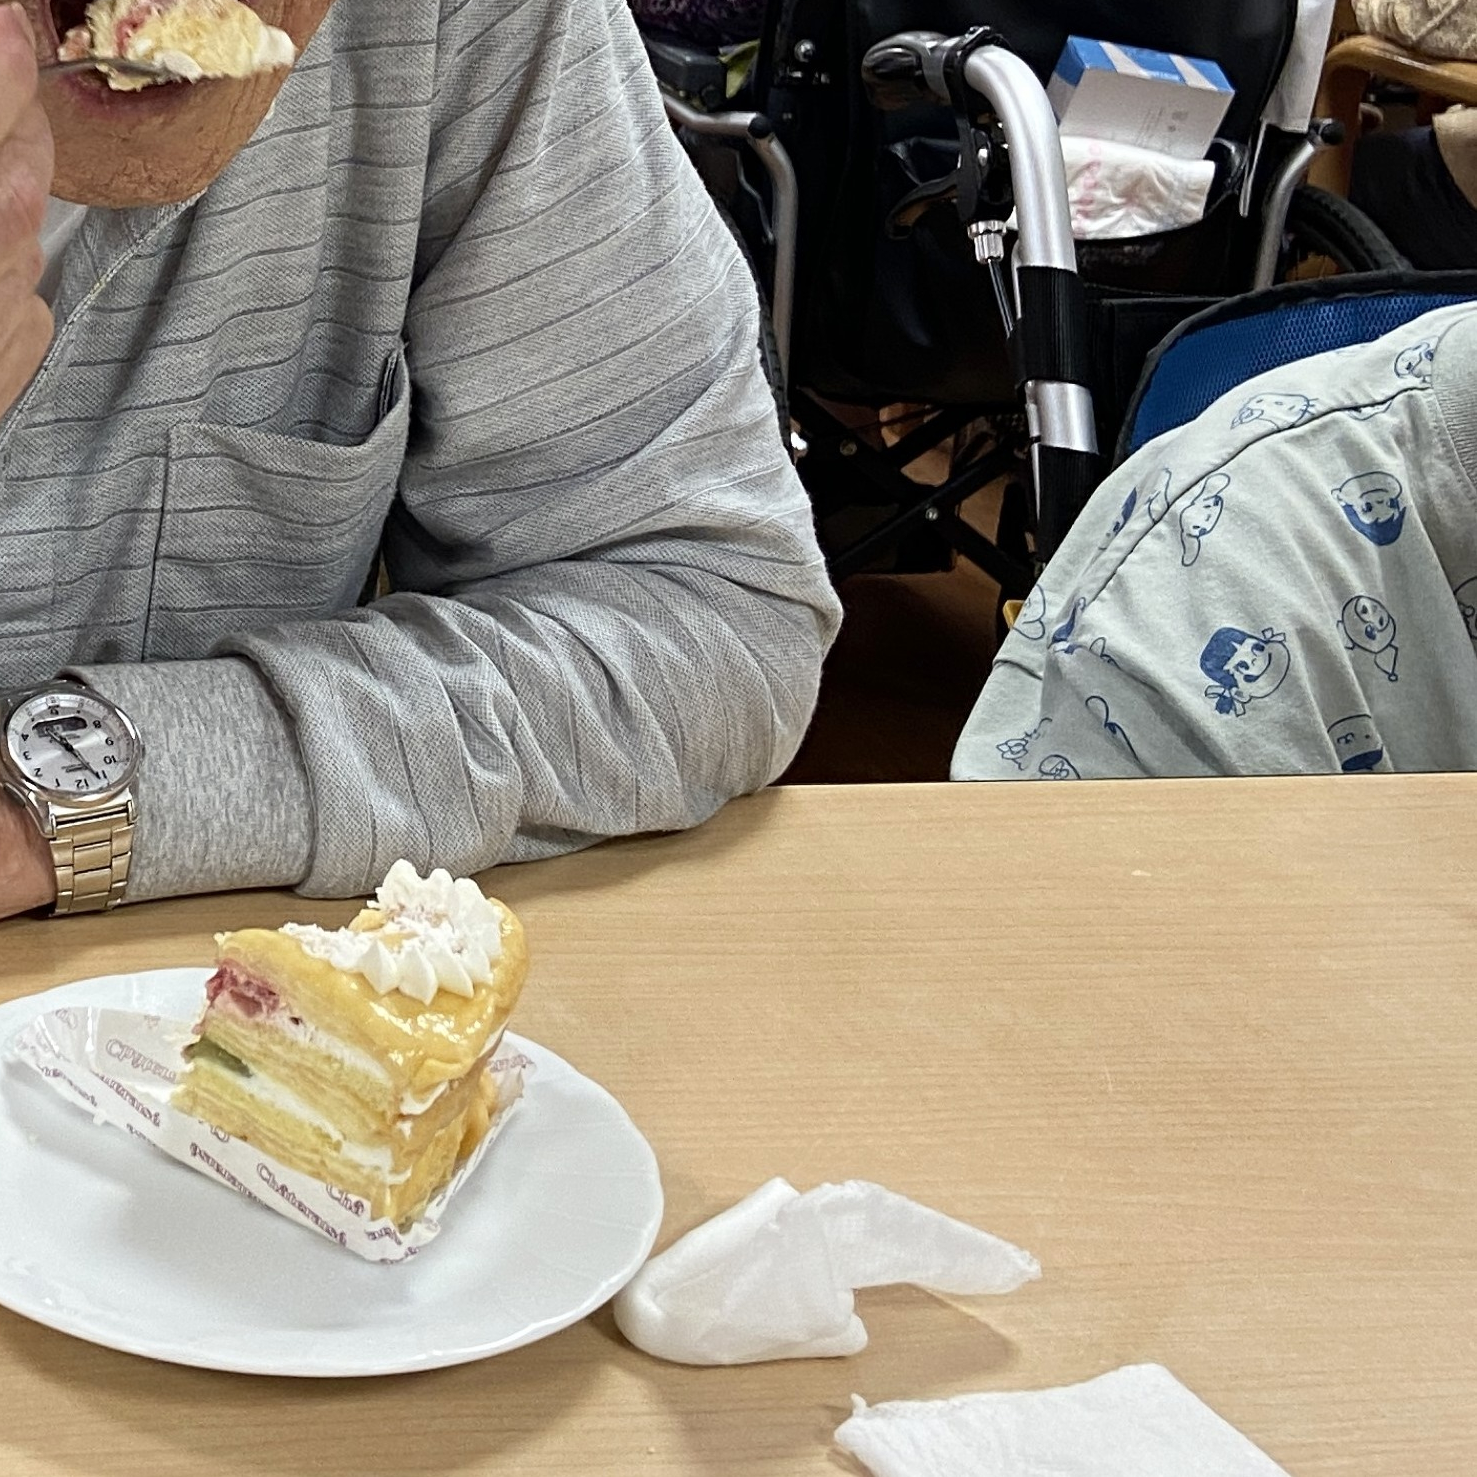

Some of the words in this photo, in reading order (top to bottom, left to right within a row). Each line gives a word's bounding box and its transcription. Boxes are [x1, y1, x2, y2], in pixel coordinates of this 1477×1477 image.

[22, 751, 32, 760] 3
[103, 755, 117, 764] 10
[33, 767, 43, 777] 2
[54, 778, 61, 788] 1
[75, 778, 90, 789] 12
